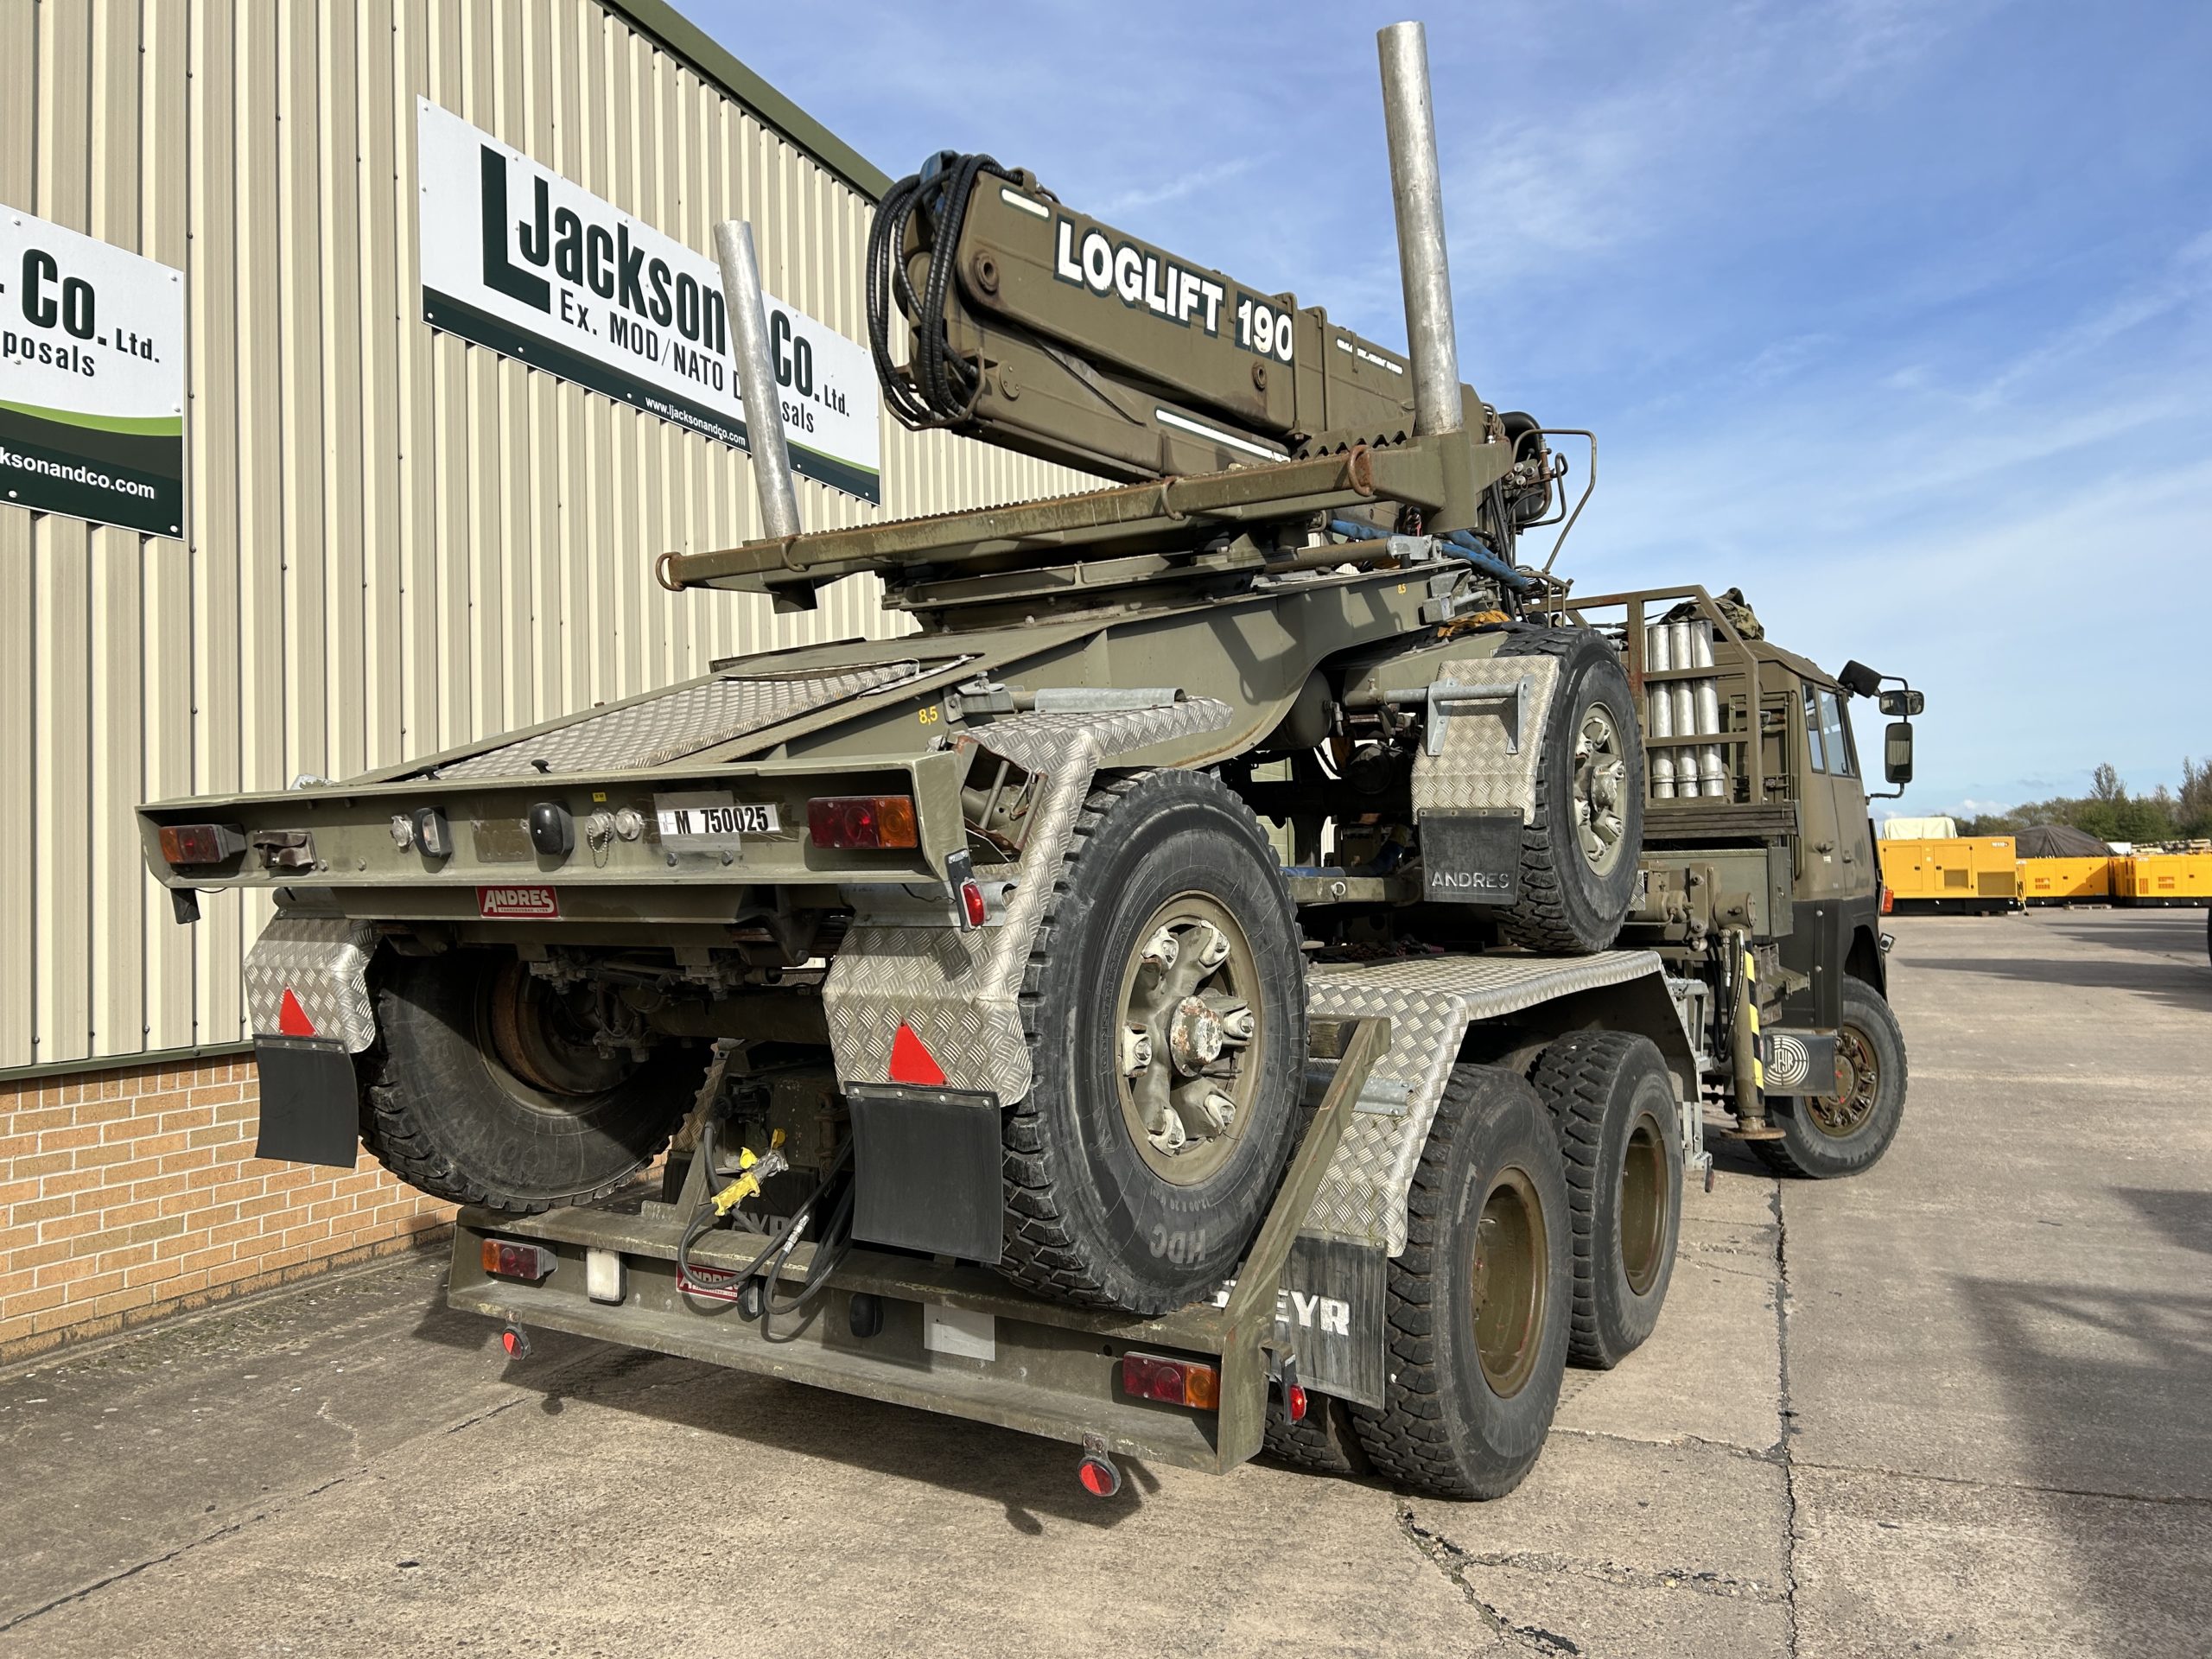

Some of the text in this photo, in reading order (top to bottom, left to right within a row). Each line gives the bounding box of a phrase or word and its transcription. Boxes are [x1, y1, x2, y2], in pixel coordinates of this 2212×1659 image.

[22, 248, 160, 363] Co. Ltd.
[1058, 221, 1294, 361] LOGLIFT 190
[560, 287, 598, 336] Ex.
[609, 310, 723, 391] MOD/NATO
[770, 309, 820, 403] Co.
[823, 384, 849, 417] Ltd.
[645, 397, 746, 447] www.ljacksonandco.com
[918, 705, 938, 726] 8,5
[674, 806, 769, 834] M 750025
[1431, 871, 1510, 889] ANDRES
[484, 889, 555, 913] ANDRES
[1770, 1048, 1794, 1073] TEYR
[1149, 1223, 1206, 1264] HDC
